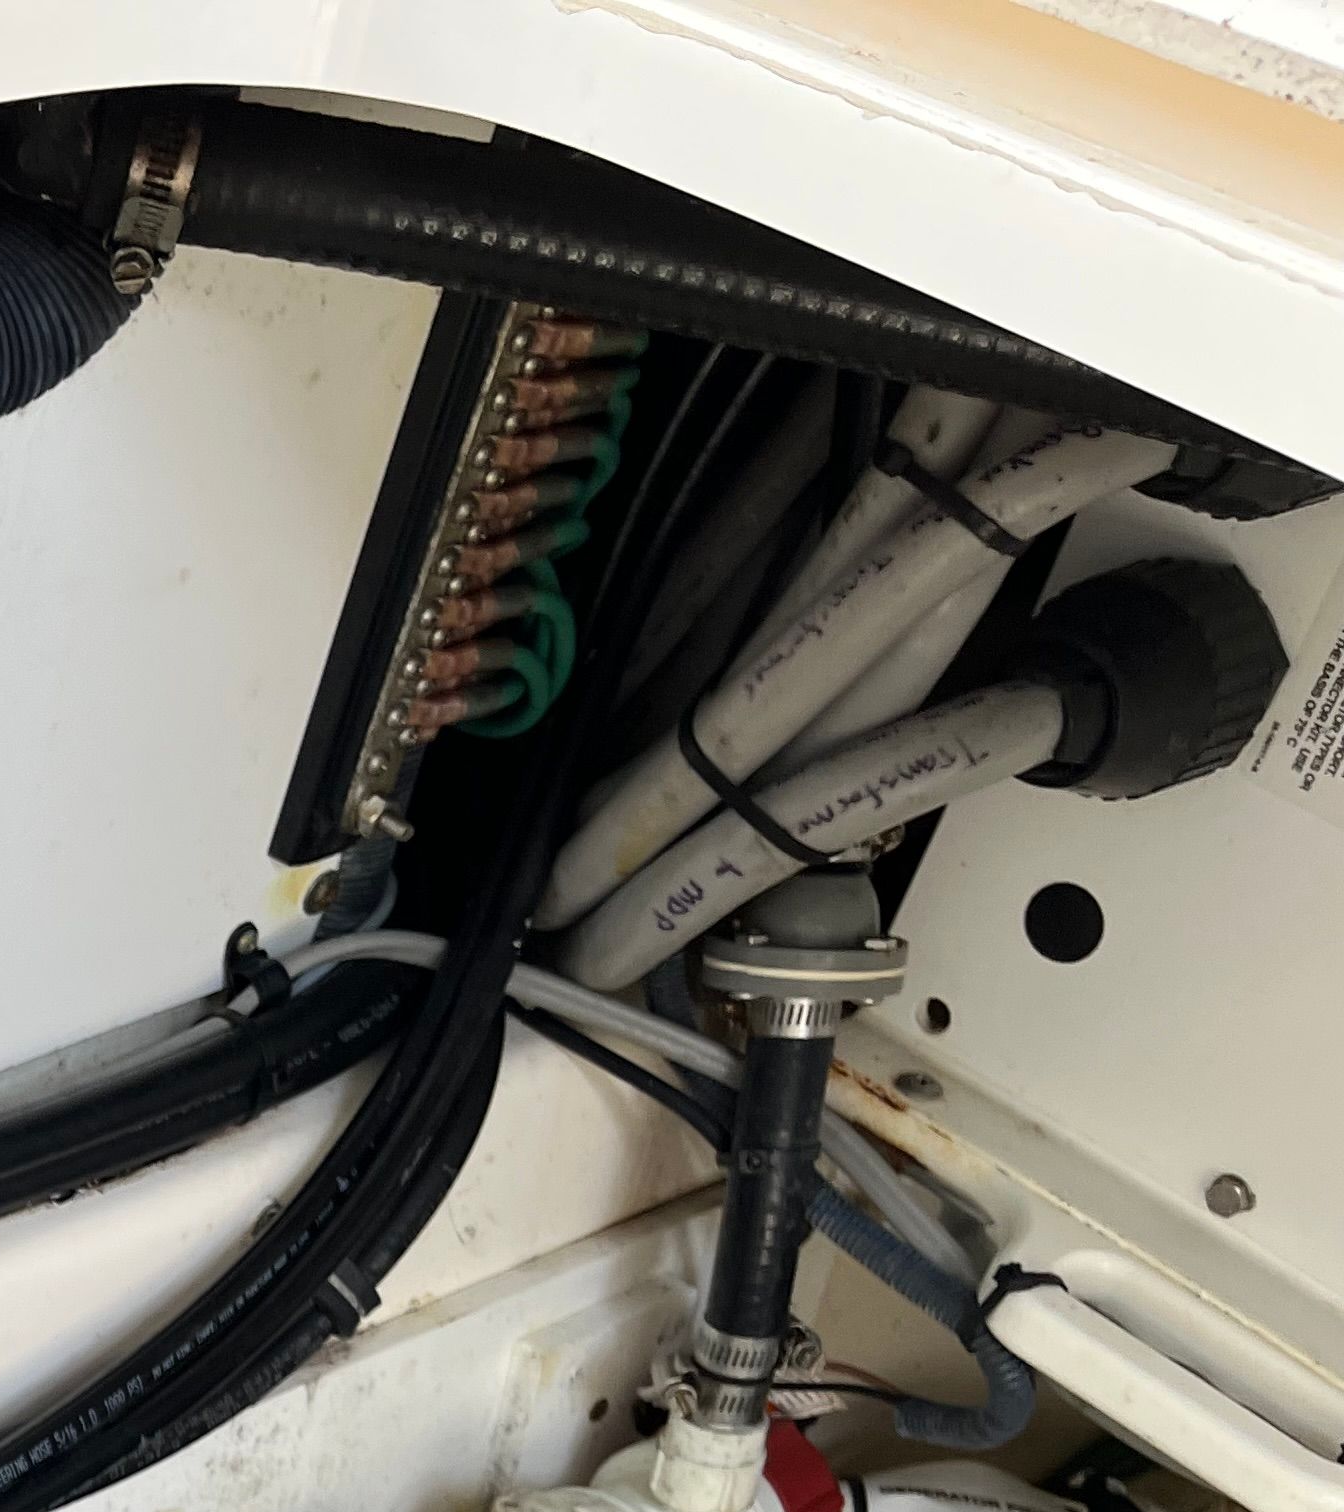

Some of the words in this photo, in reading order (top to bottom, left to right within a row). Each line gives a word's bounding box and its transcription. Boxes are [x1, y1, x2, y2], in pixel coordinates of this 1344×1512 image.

[1311, 662, 1334, 698] BASIS
[1302, 699, 1316, 716] OF
[1286, 737, 1297, 747] C
[1310, 735, 1333, 771] TYPES
[1291, 748, 1309, 772] USE
[654, 880, 706, 931] MDP
[30, 1437, 53, 1466] HOSE
